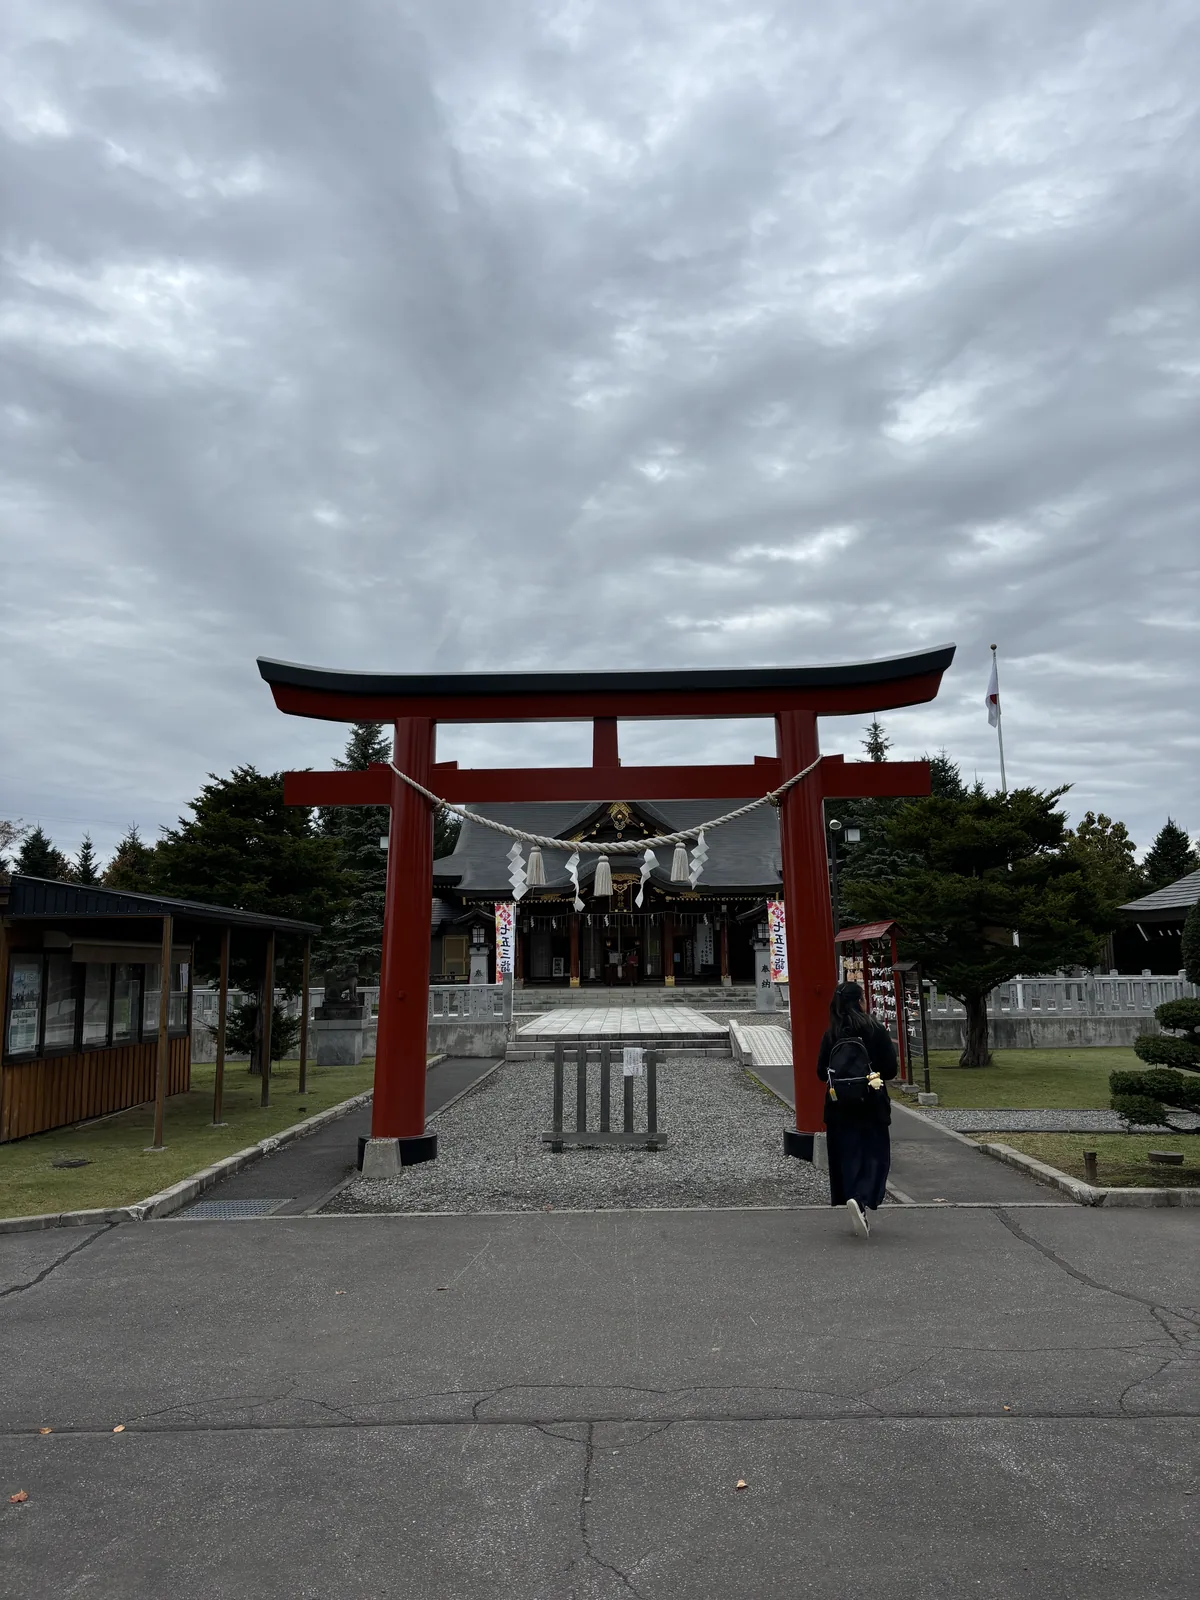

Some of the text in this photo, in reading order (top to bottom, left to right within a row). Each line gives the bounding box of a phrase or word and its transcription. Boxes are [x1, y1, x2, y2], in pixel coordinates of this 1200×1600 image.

[500, 924, 511, 973] 七五三詣
[773, 921, 785, 970] 七五三詣
[761, 964, 771, 989] 奉納
